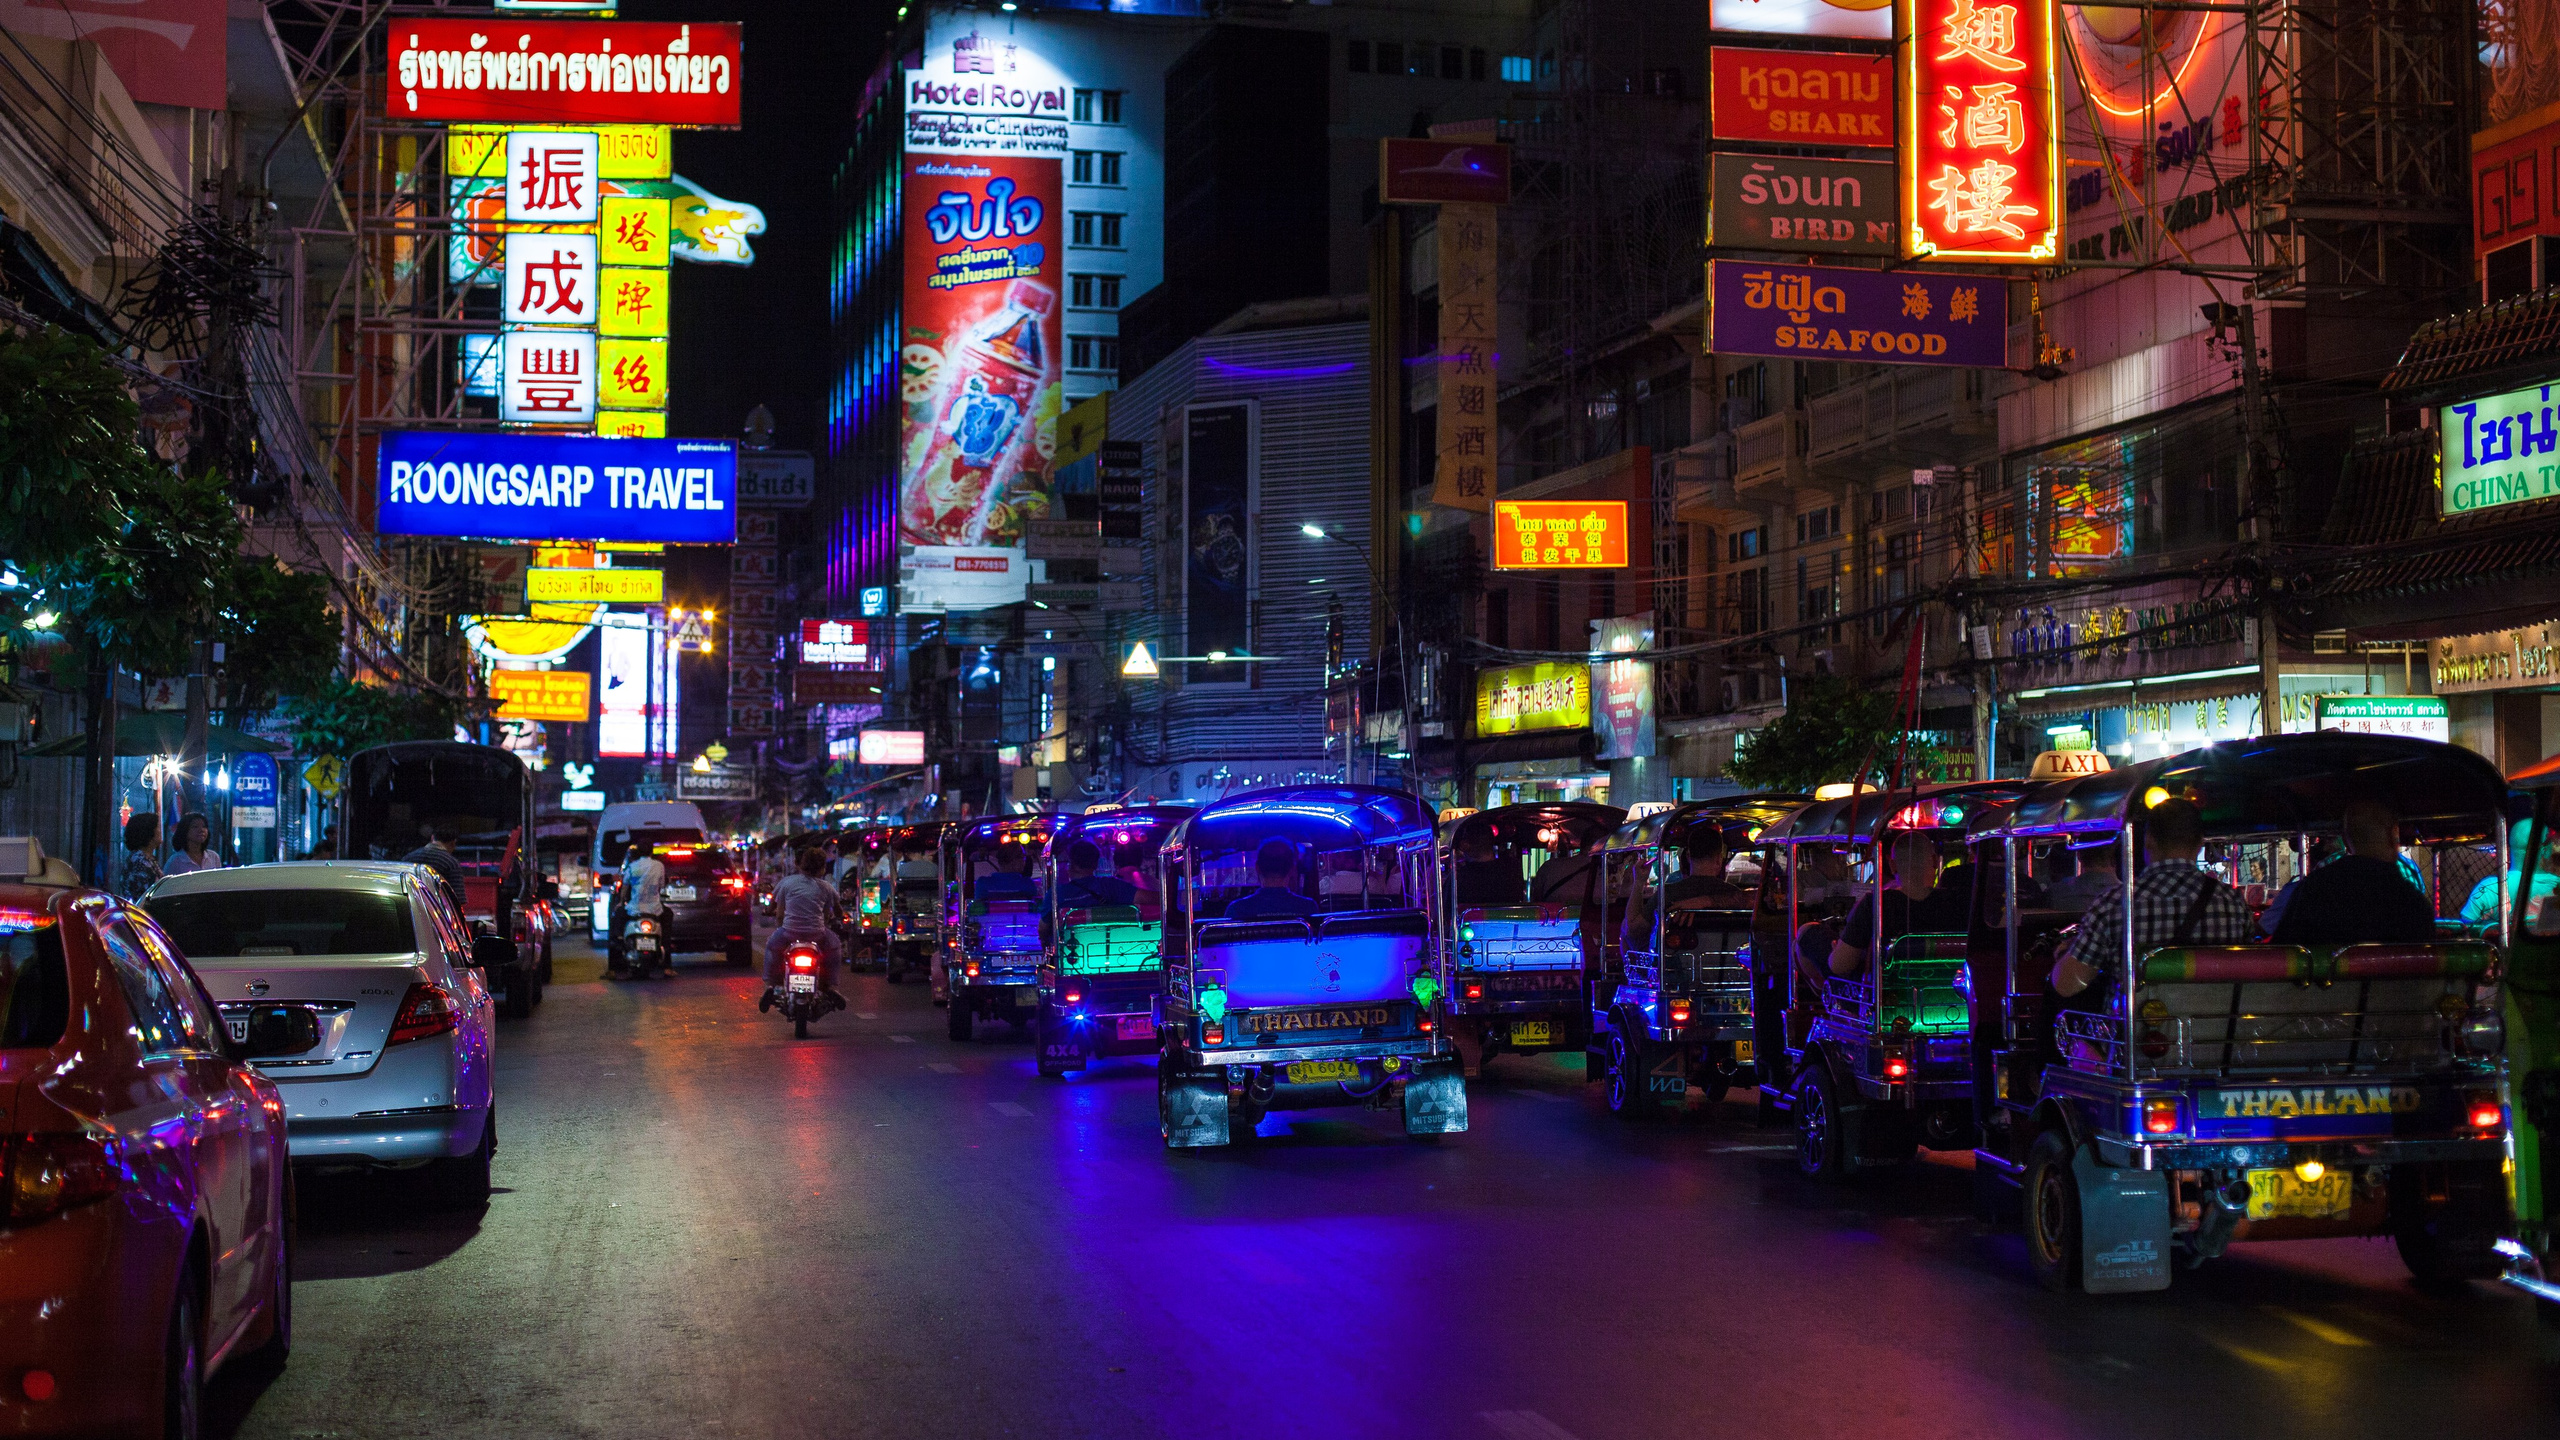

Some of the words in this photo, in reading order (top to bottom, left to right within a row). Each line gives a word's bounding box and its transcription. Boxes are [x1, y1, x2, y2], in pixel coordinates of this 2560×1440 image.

[398, 25, 732, 112] รุ่งทรัพย์การท่องเที่ยว
[911, 80, 986, 107] Hotel
[991, 83, 1066, 116] Royal
[1740, 65, 1879, 110] หูฉลาม
[1768, 110, 1883, 136] SHARK
[1740, 162, 1861, 207] รังนก
[925, 177, 1045, 245] จับใจ
[1769, 216, 1856, 241] BIRD
[1866, 219, 1895, 243] N
[1009, 241, 1046, 268] 10
[517, 147, 585, 413] 振成豐
[1902, 281, 1979, 324] 海鮮
[1774, 325, 1947, 357] SEAFOOD
[2451, 383, 2560, 470] ไชน่
[390, 460, 595, 508] ROONGSARP
[604, 466, 723, 511] TRAVEL
[1103, 484, 1140, 495] RADO
[2452, 470, 2531, 511] CHINA
[2538, 464, 2560, 495] T
[1511, 512, 1543, 532] ไทย
[1521, 548, 1603, 563] 批发干果
[2326, 703, 2367, 716] ภัตตาคาร
[2367, 701, 2415, 716] ไชน่าทาวน์
[2047, 754, 2098, 772] TAXI
[1249, 1009, 1388, 1033] THAILAND
[1318, 1062, 1354, 1075] 6047
[1650, 1077, 1686, 1093] WD
[2219, 1086, 2421, 1118] THAILAND
